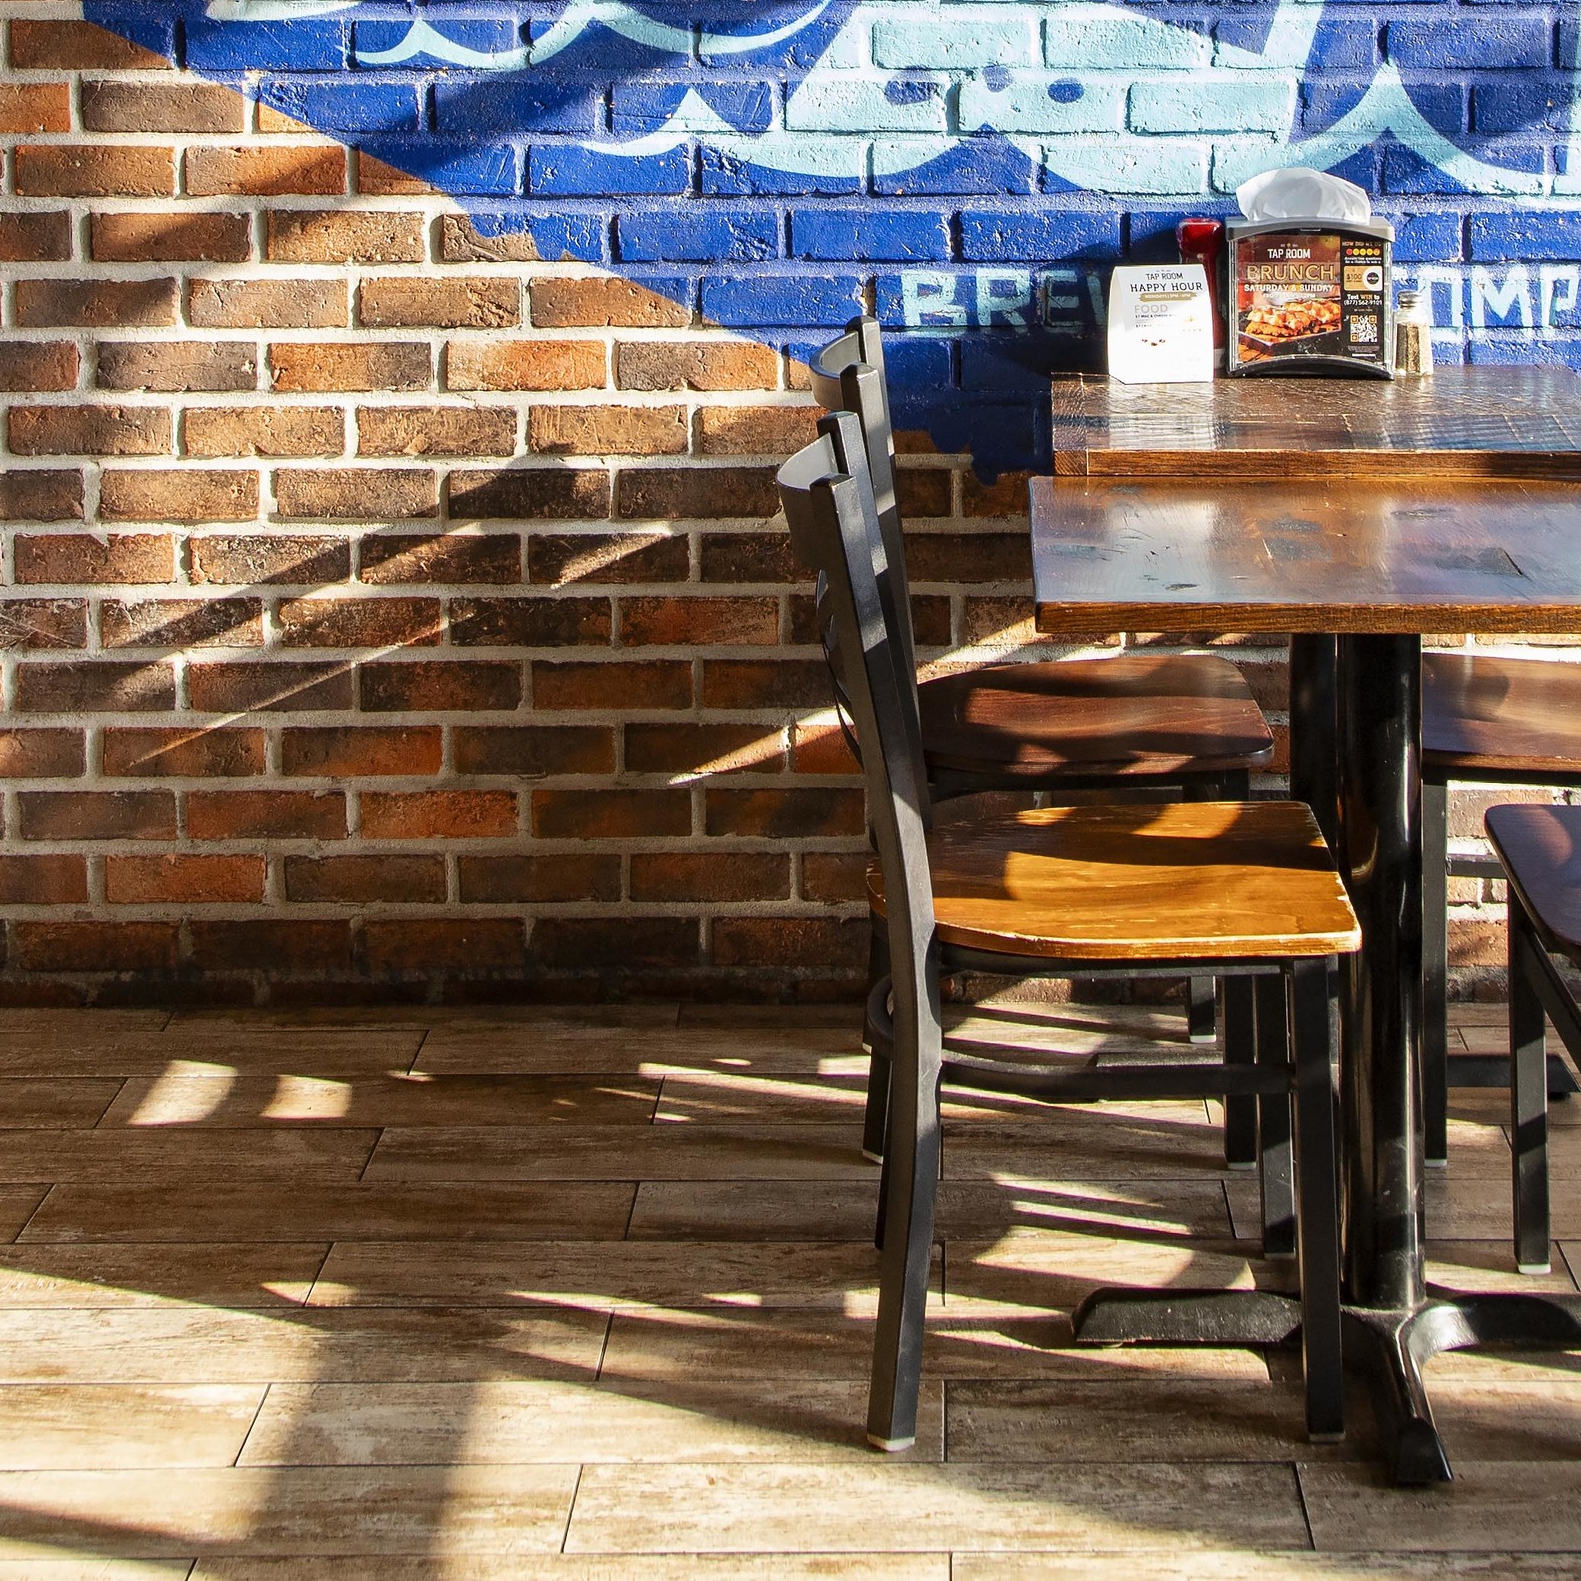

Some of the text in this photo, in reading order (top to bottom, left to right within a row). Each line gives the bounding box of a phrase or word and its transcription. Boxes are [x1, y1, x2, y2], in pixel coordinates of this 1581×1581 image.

[1268, 248, 1311, 259] TAP ROOM
[1162, 272, 1184, 280] ROOM
[1247, 264, 1335, 281] BRUNCH
[1130, 282, 1203, 292] HAPPY HOUR
[1244, 284, 1289, 292] SATURDAY
[1299, 284, 1335, 292] SUNDAY
[1134, 304, 1168, 313] FOOD
